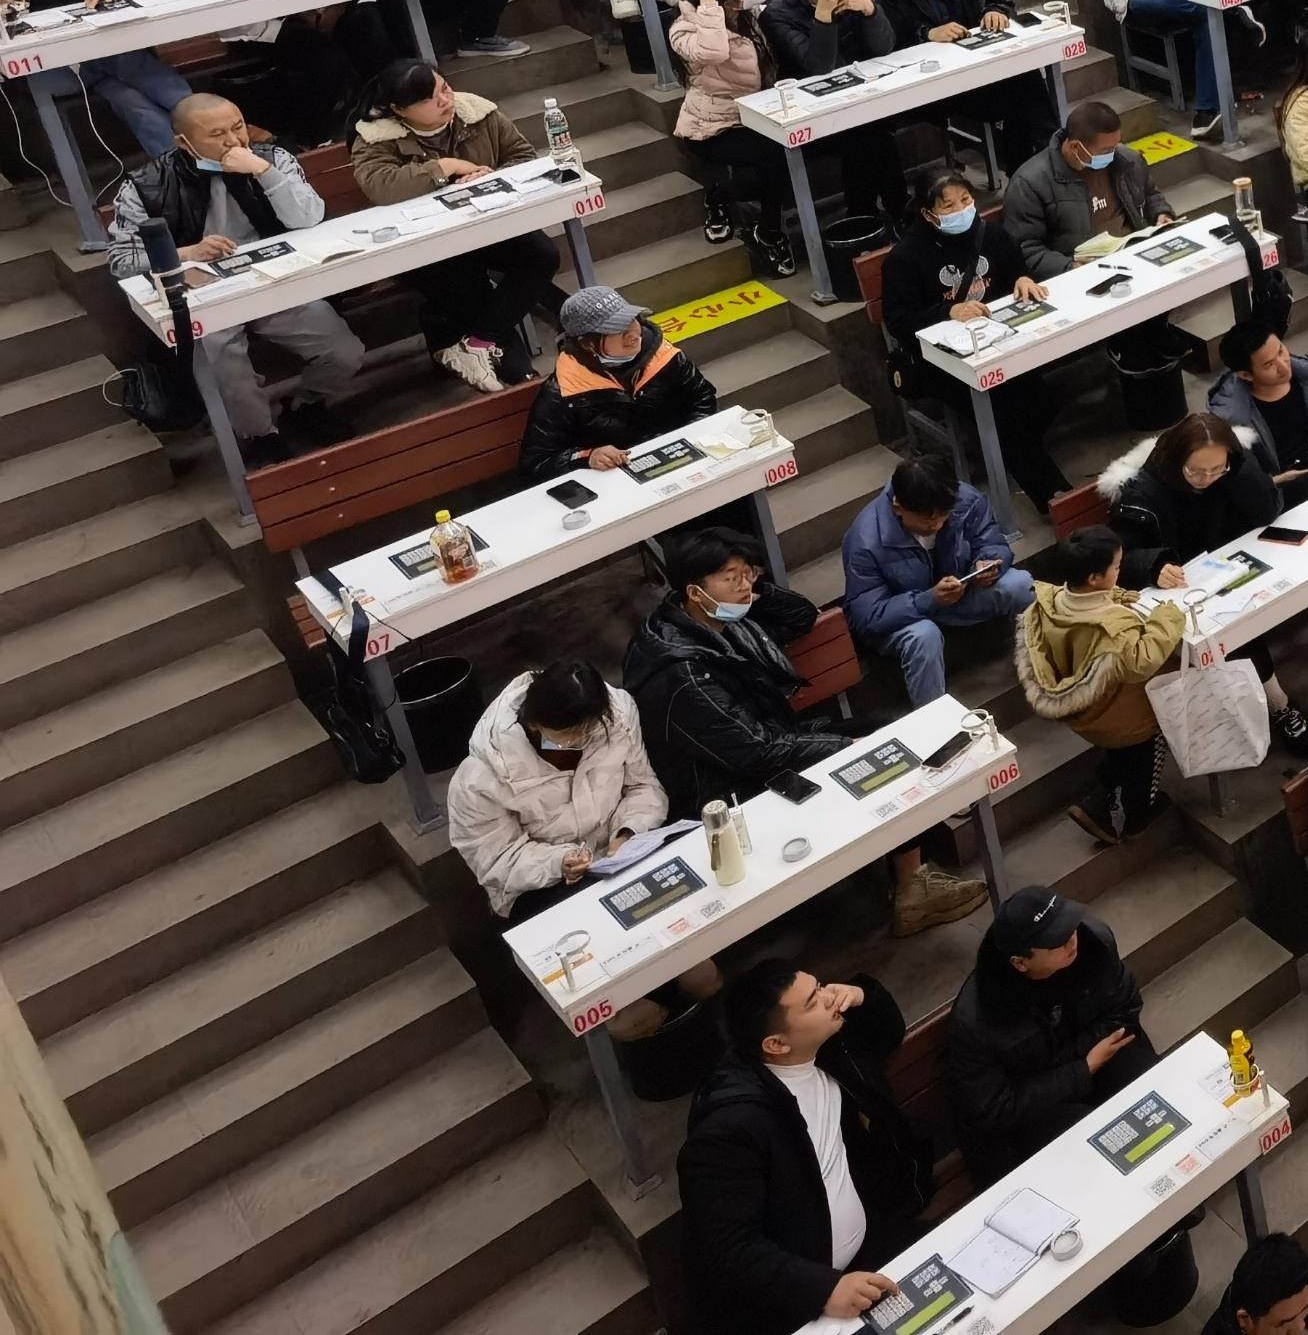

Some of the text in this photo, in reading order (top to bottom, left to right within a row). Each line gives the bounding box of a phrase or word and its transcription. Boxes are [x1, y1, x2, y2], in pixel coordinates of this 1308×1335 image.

[1063, 41, 1086, 58] 028
[8, 55, 43, 76] 011
[788, 127, 812, 147] 027
[575, 195, 604, 215] 010
[1263, 250, 1279, 267] 26
[166, 319, 204, 344] 09
[979, 367, 1005, 390] 025
[767, 461, 797, 484] 008
[366, 634, 392, 657] 07
[989, 764, 1019, 790] 006
[574, 1001, 613, 1033] 005
[1261, 1119, 1292, 1151] 004
